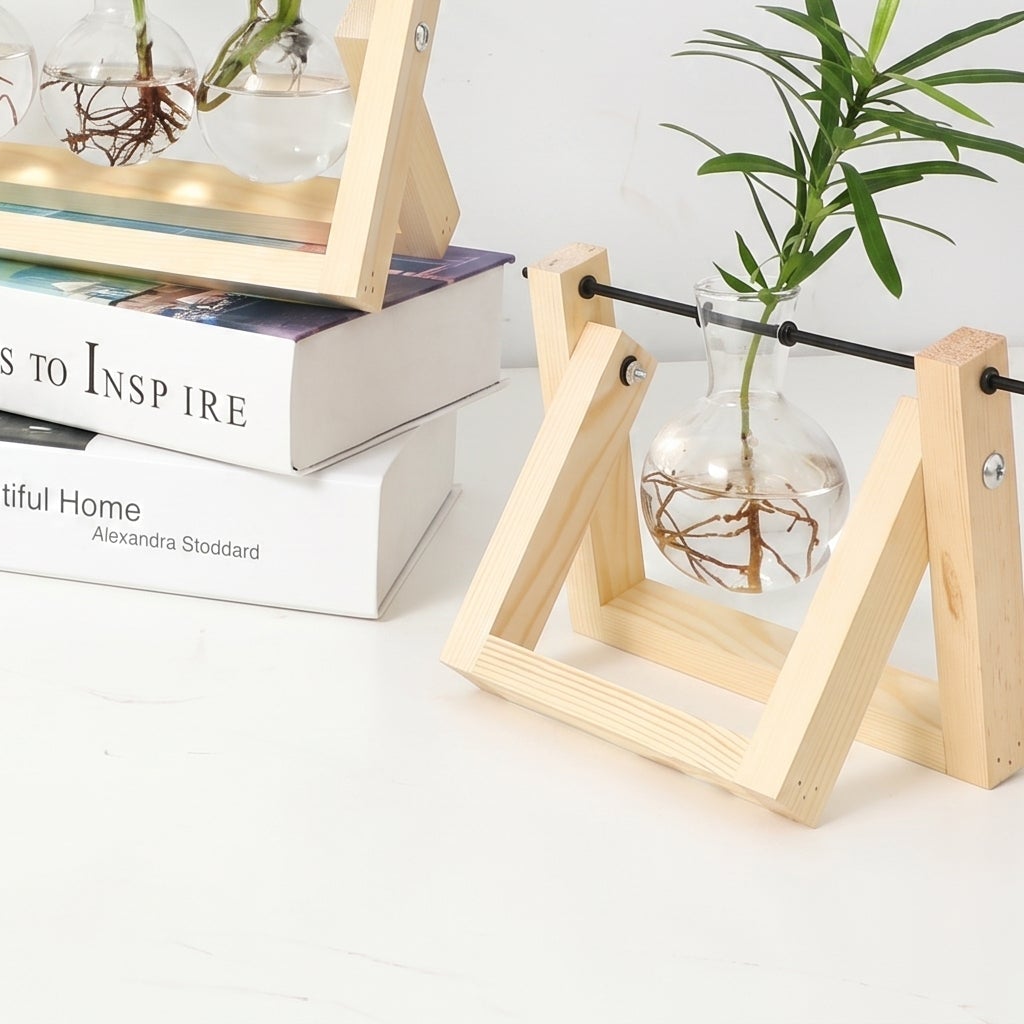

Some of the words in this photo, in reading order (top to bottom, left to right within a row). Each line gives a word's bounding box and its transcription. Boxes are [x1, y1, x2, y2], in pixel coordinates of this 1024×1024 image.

[29, 352, 68, 387] TO
[60, 488, 141, 522] Home
[91, 525, 177, 551] Alexandra
[182, 535, 260, 560] Stoddard
